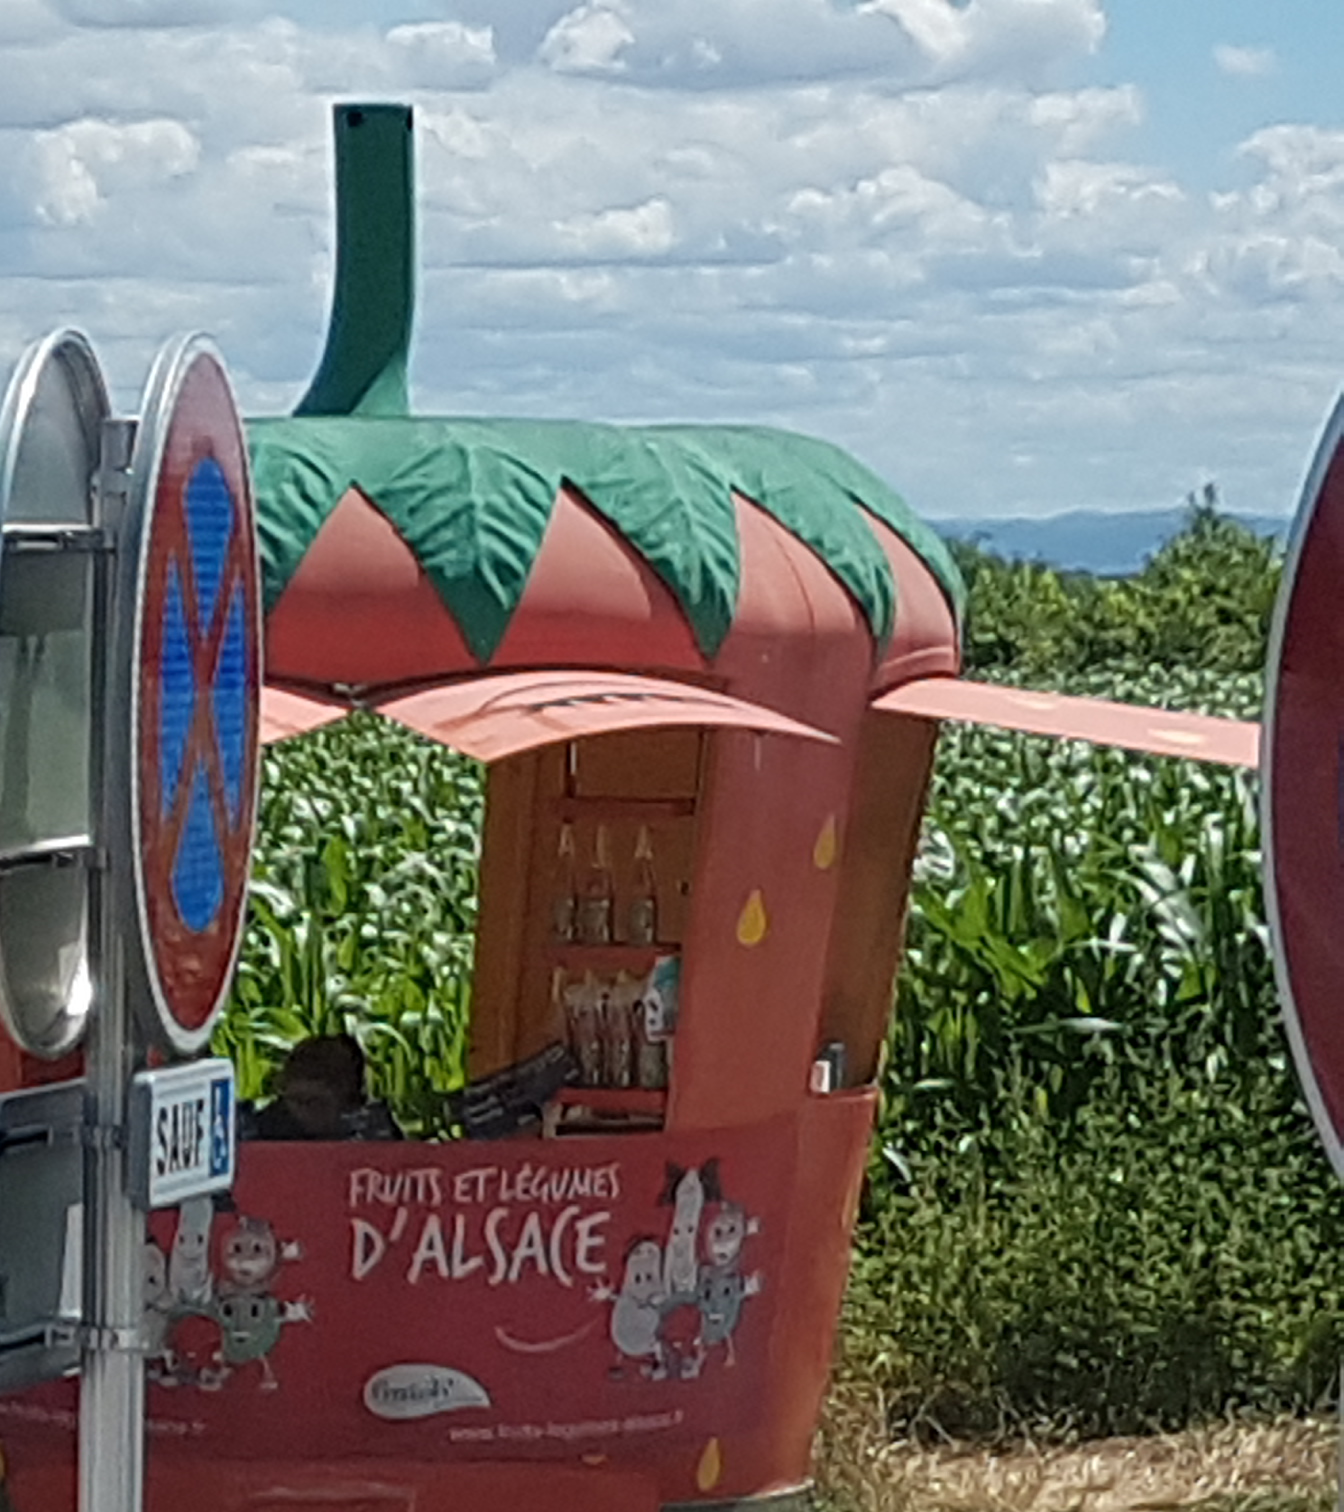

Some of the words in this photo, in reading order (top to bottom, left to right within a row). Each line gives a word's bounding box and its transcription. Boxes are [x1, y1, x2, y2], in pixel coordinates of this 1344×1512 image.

[157, 1098, 204, 1177] SAUF
[349, 1167, 443, 1207] FRUITS
[453, 1166, 498, 1202] ET
[499, 1162, 621, 1203] LÉGUMES
[350, 1204, 611, 1287] D'ALSACE
